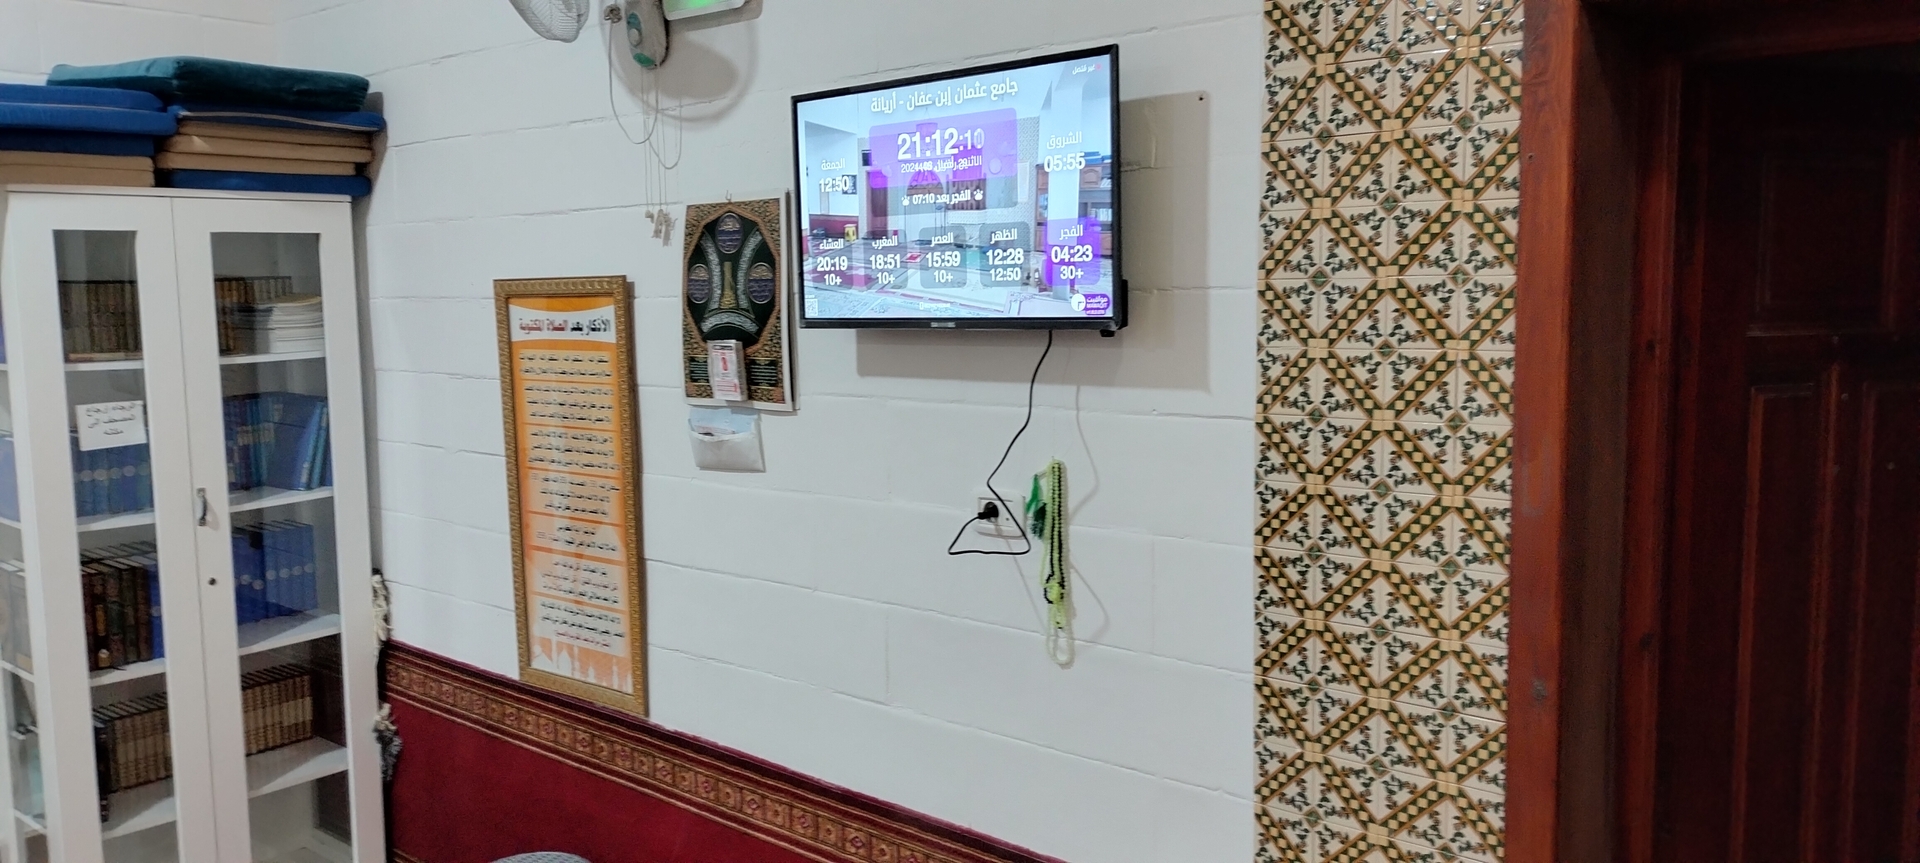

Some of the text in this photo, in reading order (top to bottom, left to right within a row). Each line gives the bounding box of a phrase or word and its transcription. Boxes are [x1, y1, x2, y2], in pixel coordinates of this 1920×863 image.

[954, 81, 987, 104] عثمان
[990, 77, 1019, 103] جامع
[870, 92, 897, 114] أريانة
[906, 90, 933, 111] عفان
[1046, 131, 1082, 150] الشروق
[821, 157, 846, 171] الجمعة
[1044, 152, 1086, 173] 05:55
[819, 175, 849, 193] 12:50
[912, 189, 971, 205] الفجر بعد 07:10
[930, 232, 954, 247] العصر
[990, 228, 1018, 245] الظهر
[1059, 224, 1084, 241] الفجر
[819, 238, 844, 250] العشاء
[872, 235, 898, 250] المغرب
[869, 253, 901, 270] 18:51
[926, 251, 961, 268] 15:59
[986, 247, 1024, 266] 12:28
[1051, 244, 1093, 263] 04:23
[817, 256, 848, 271] 20:19
[990, 267, 1021, 282] 12:50
